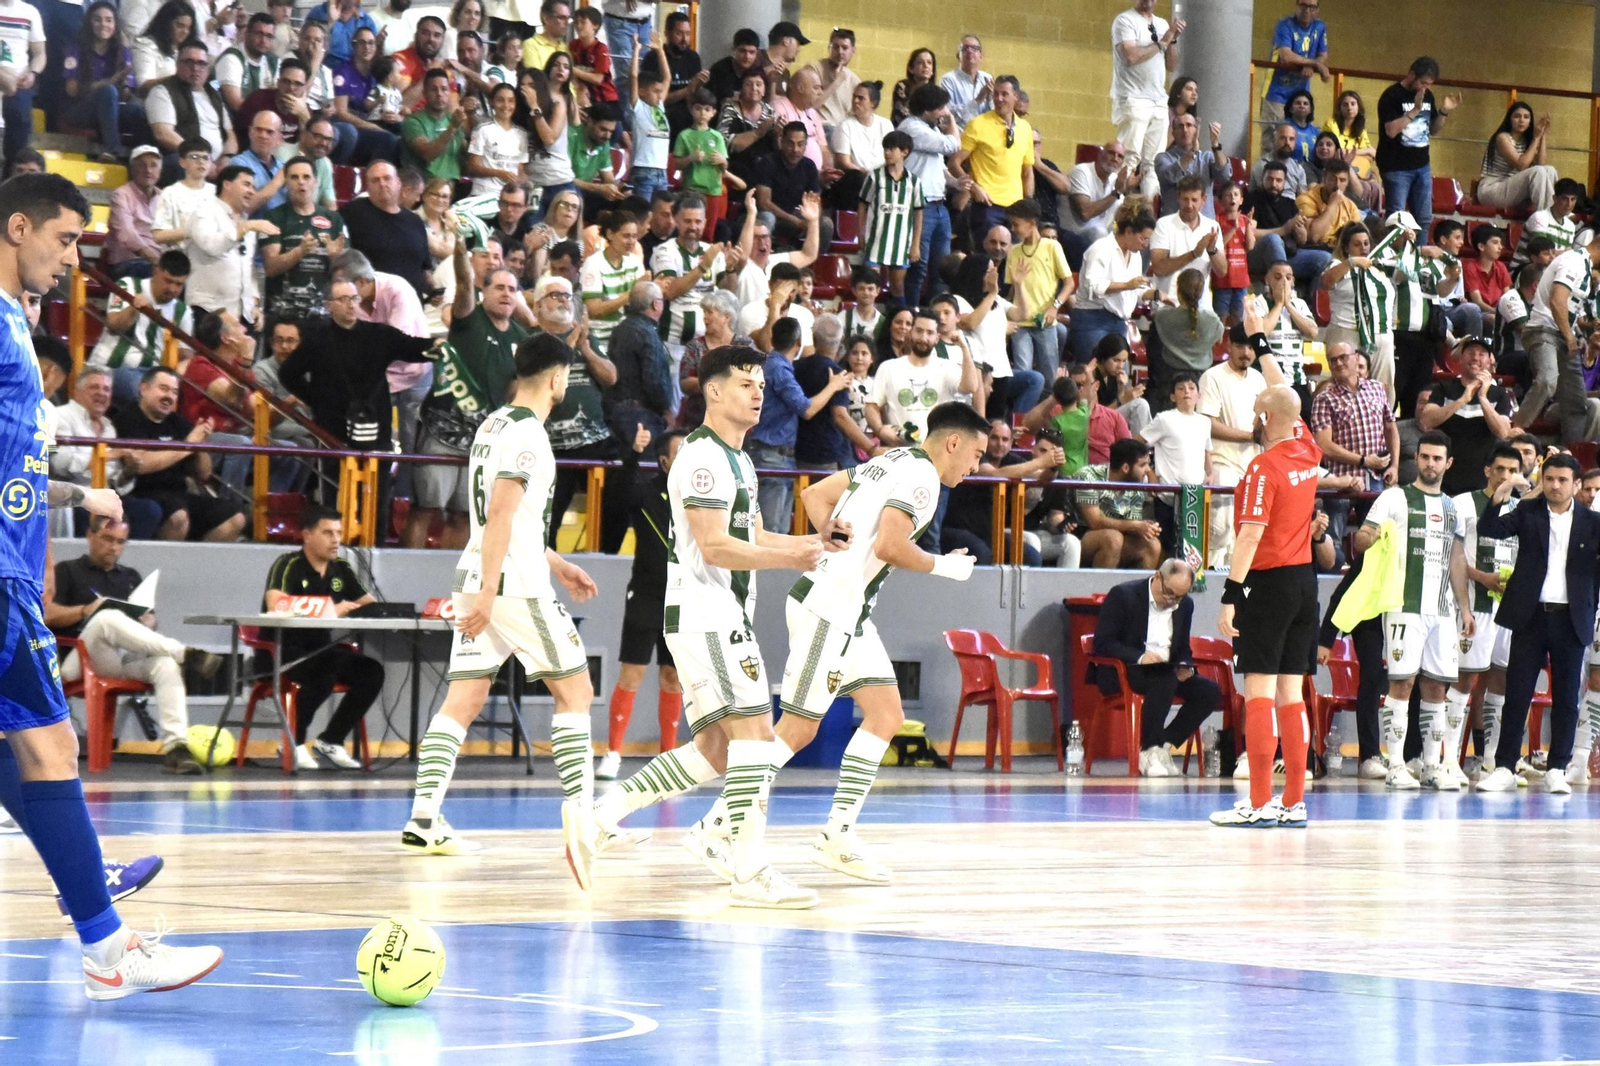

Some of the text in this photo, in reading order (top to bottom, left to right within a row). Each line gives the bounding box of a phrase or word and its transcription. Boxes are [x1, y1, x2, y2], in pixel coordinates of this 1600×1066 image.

[1186, 511, 1198, 538] CF
[840, 632, 852, 657] 7
[1391, 624, 1406, 640] 77
[382, 922, 403, 962] Joma
